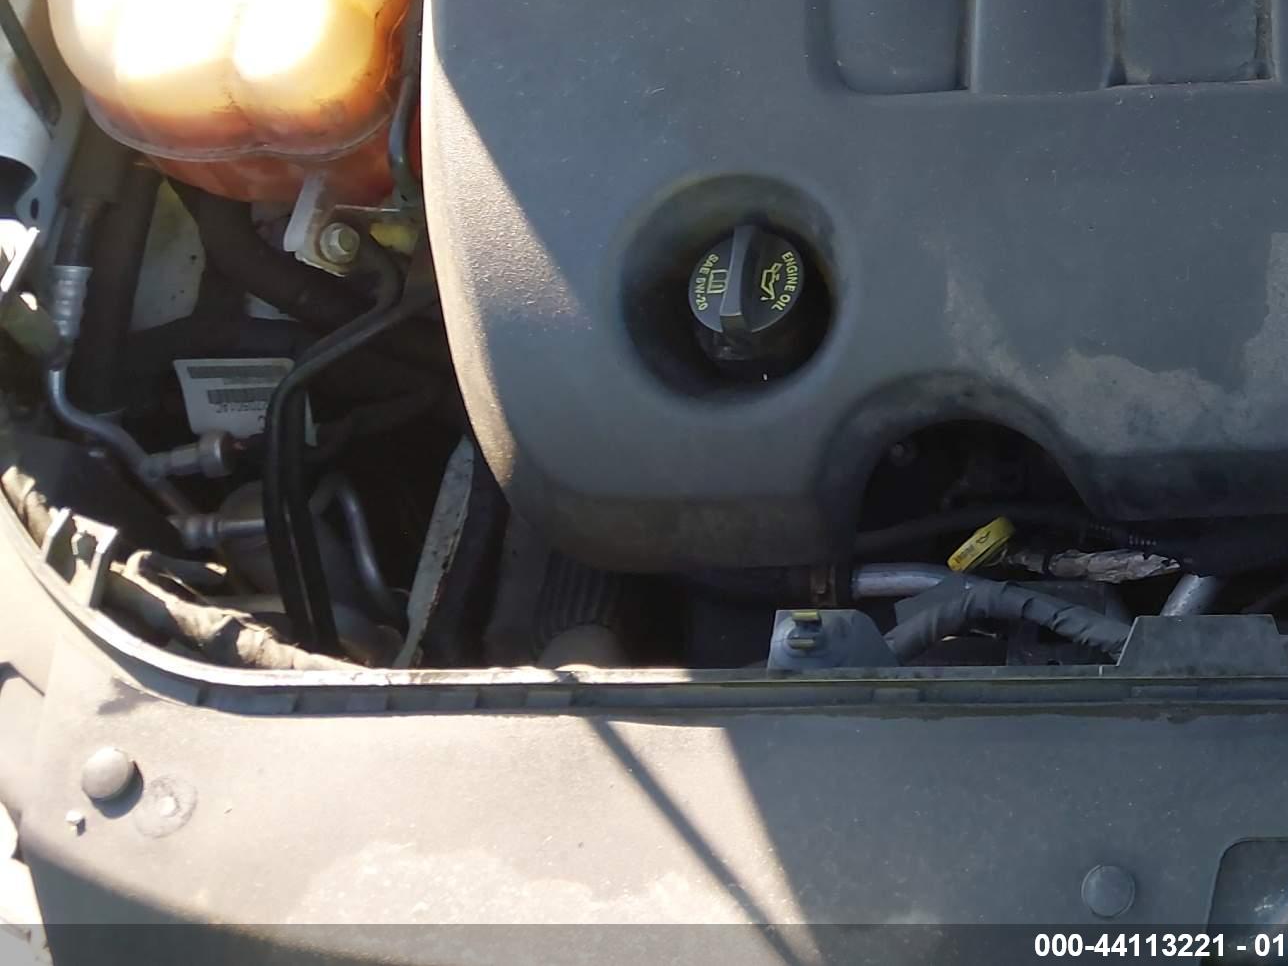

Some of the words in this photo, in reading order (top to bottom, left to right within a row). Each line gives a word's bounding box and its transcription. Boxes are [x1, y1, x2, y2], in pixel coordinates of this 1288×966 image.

[698, 253, 719, 275] SAE
[781, 251, 799, 292] ENGINE
[695, 277, 709, 311] 5W-20
[771, 294, 791, 311] OIL
